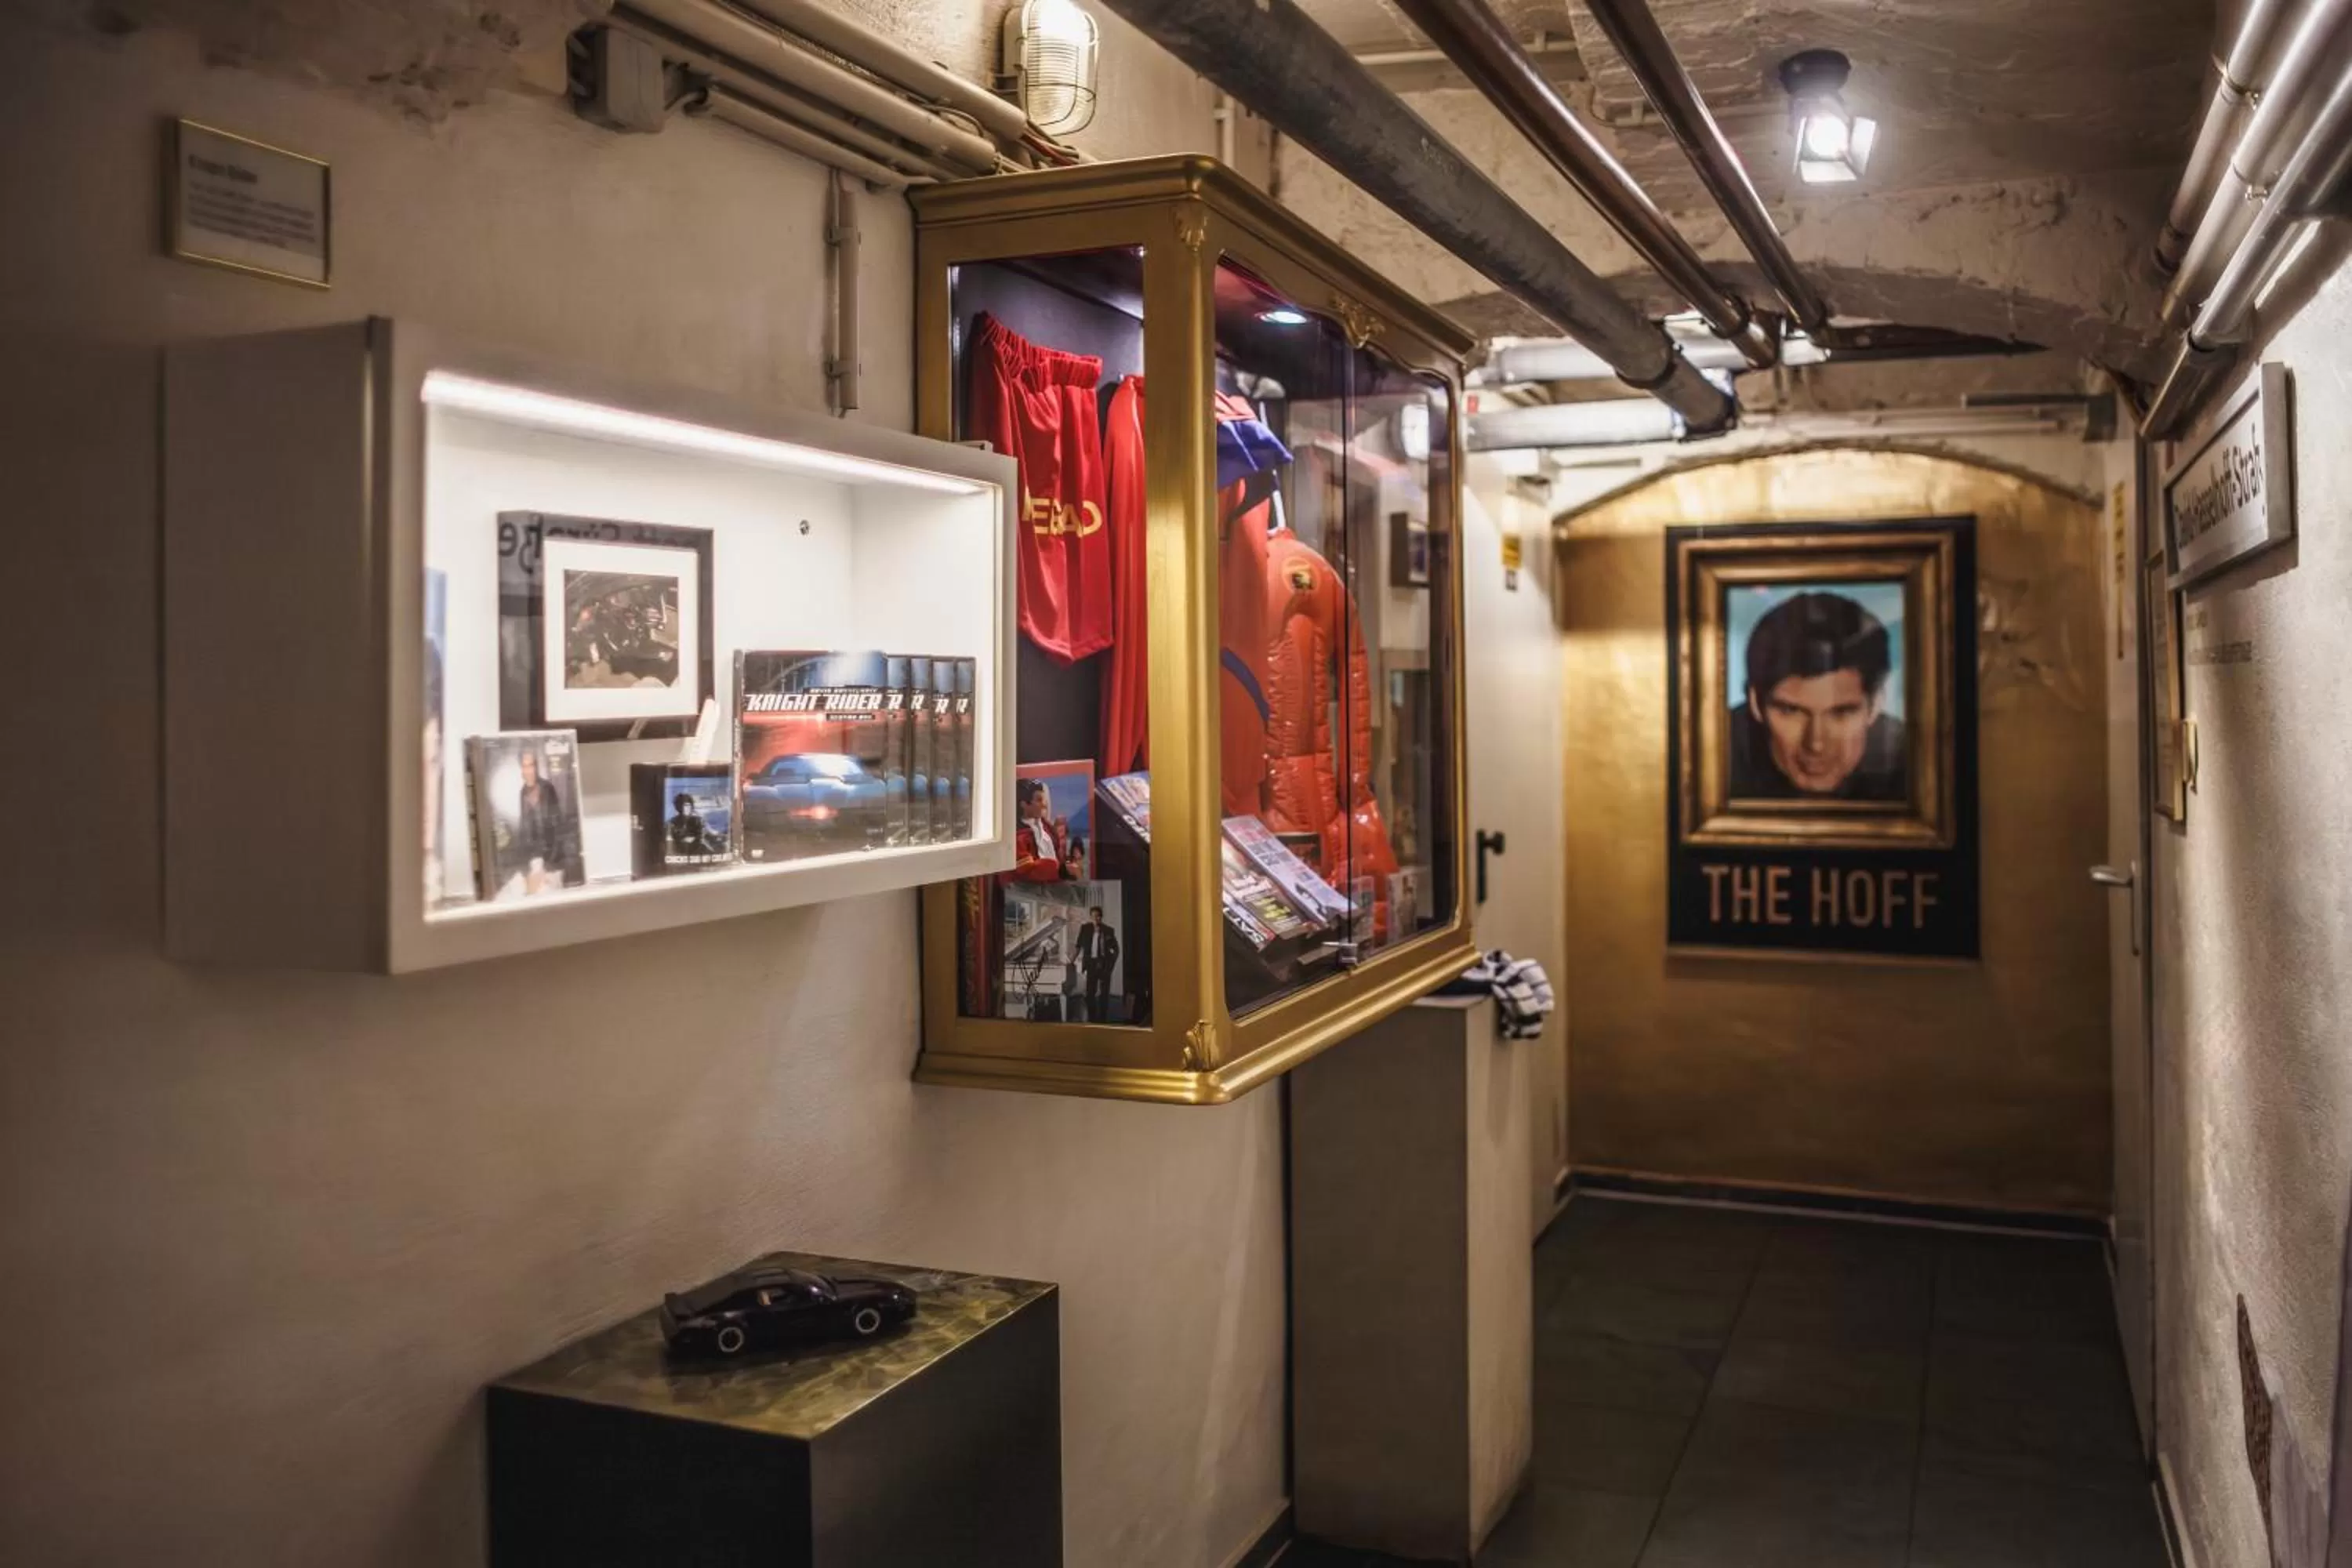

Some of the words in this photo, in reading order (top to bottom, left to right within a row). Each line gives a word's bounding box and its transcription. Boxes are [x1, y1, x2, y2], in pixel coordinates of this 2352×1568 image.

[745, 693, 820, 710] KNIGHT
[823, 692, 882, 710] RIDER
[1701, 865, 1792, 924] THE
[1812, 866, 1939, 928] HOFF
